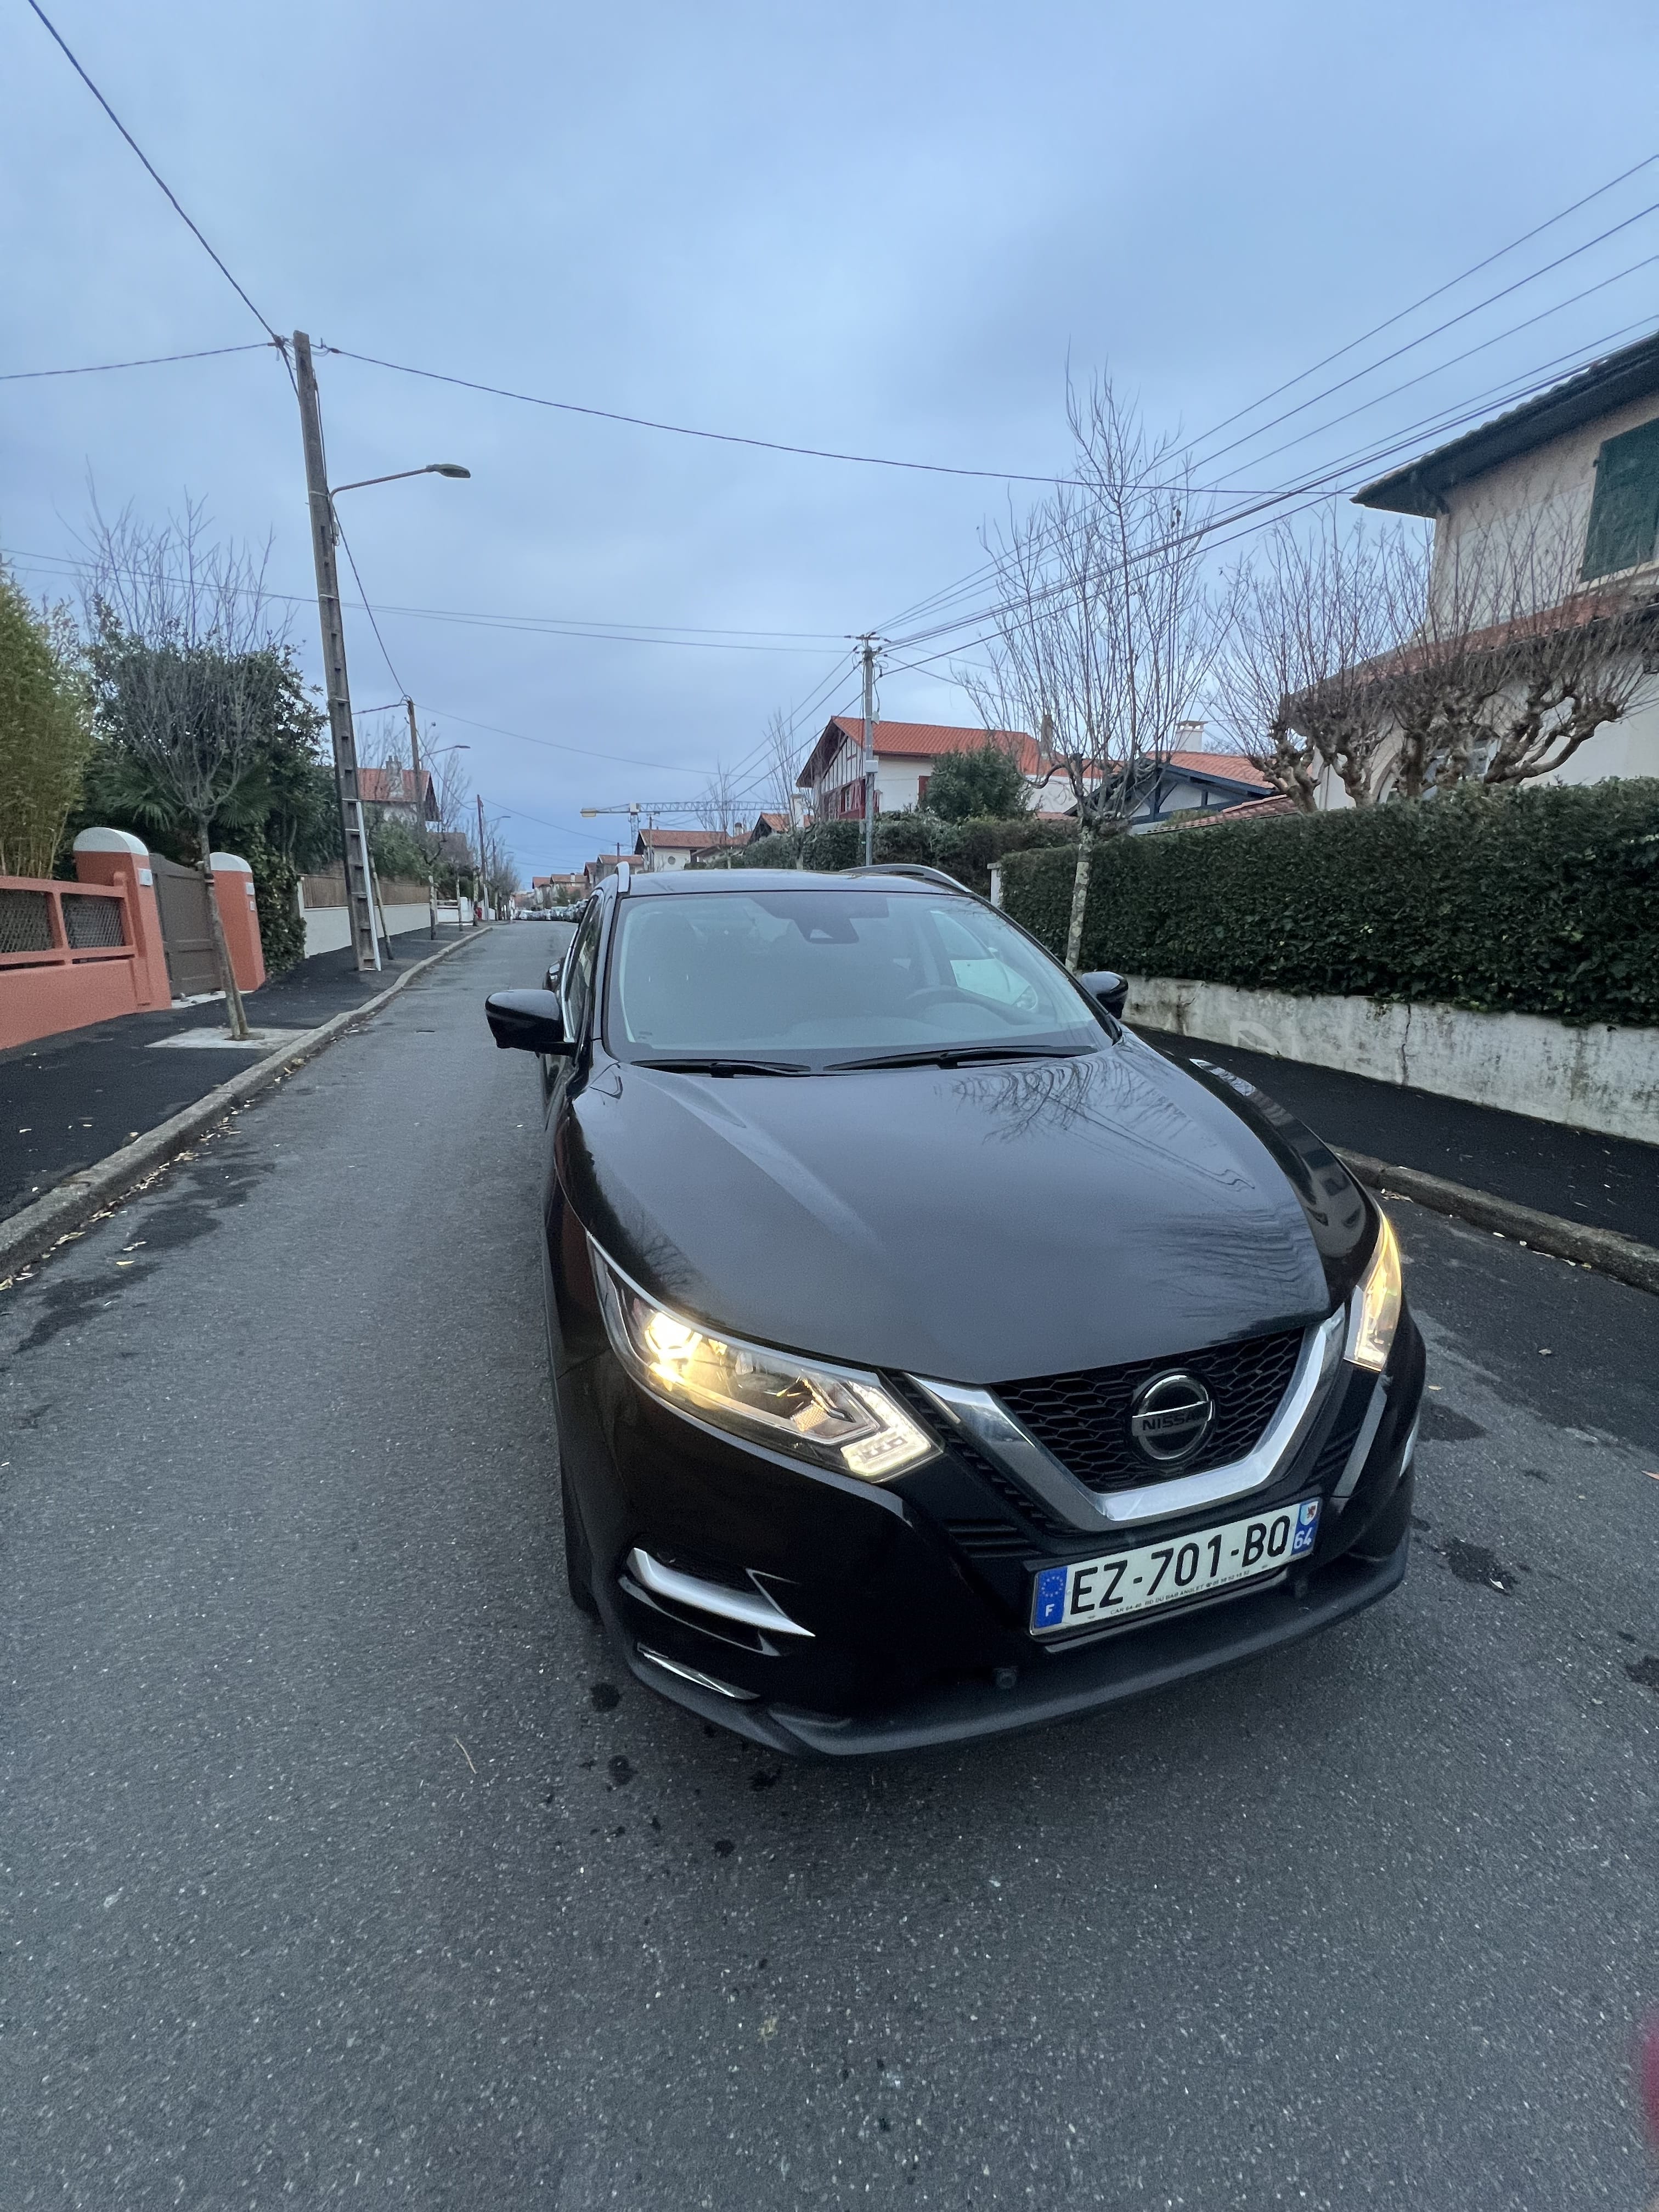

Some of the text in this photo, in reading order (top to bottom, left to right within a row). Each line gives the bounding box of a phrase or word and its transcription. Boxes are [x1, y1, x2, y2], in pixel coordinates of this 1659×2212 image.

[1143, 1409, 1203, 1430] NISSA
[1294, 1527, 1313, 1549] 64
[1070, 1515, 1290, 1615] EZ-701-BQ
[1180, 1584, 1204, 1595] ANGLET
[1045, 1603, 1055, 1617] F
